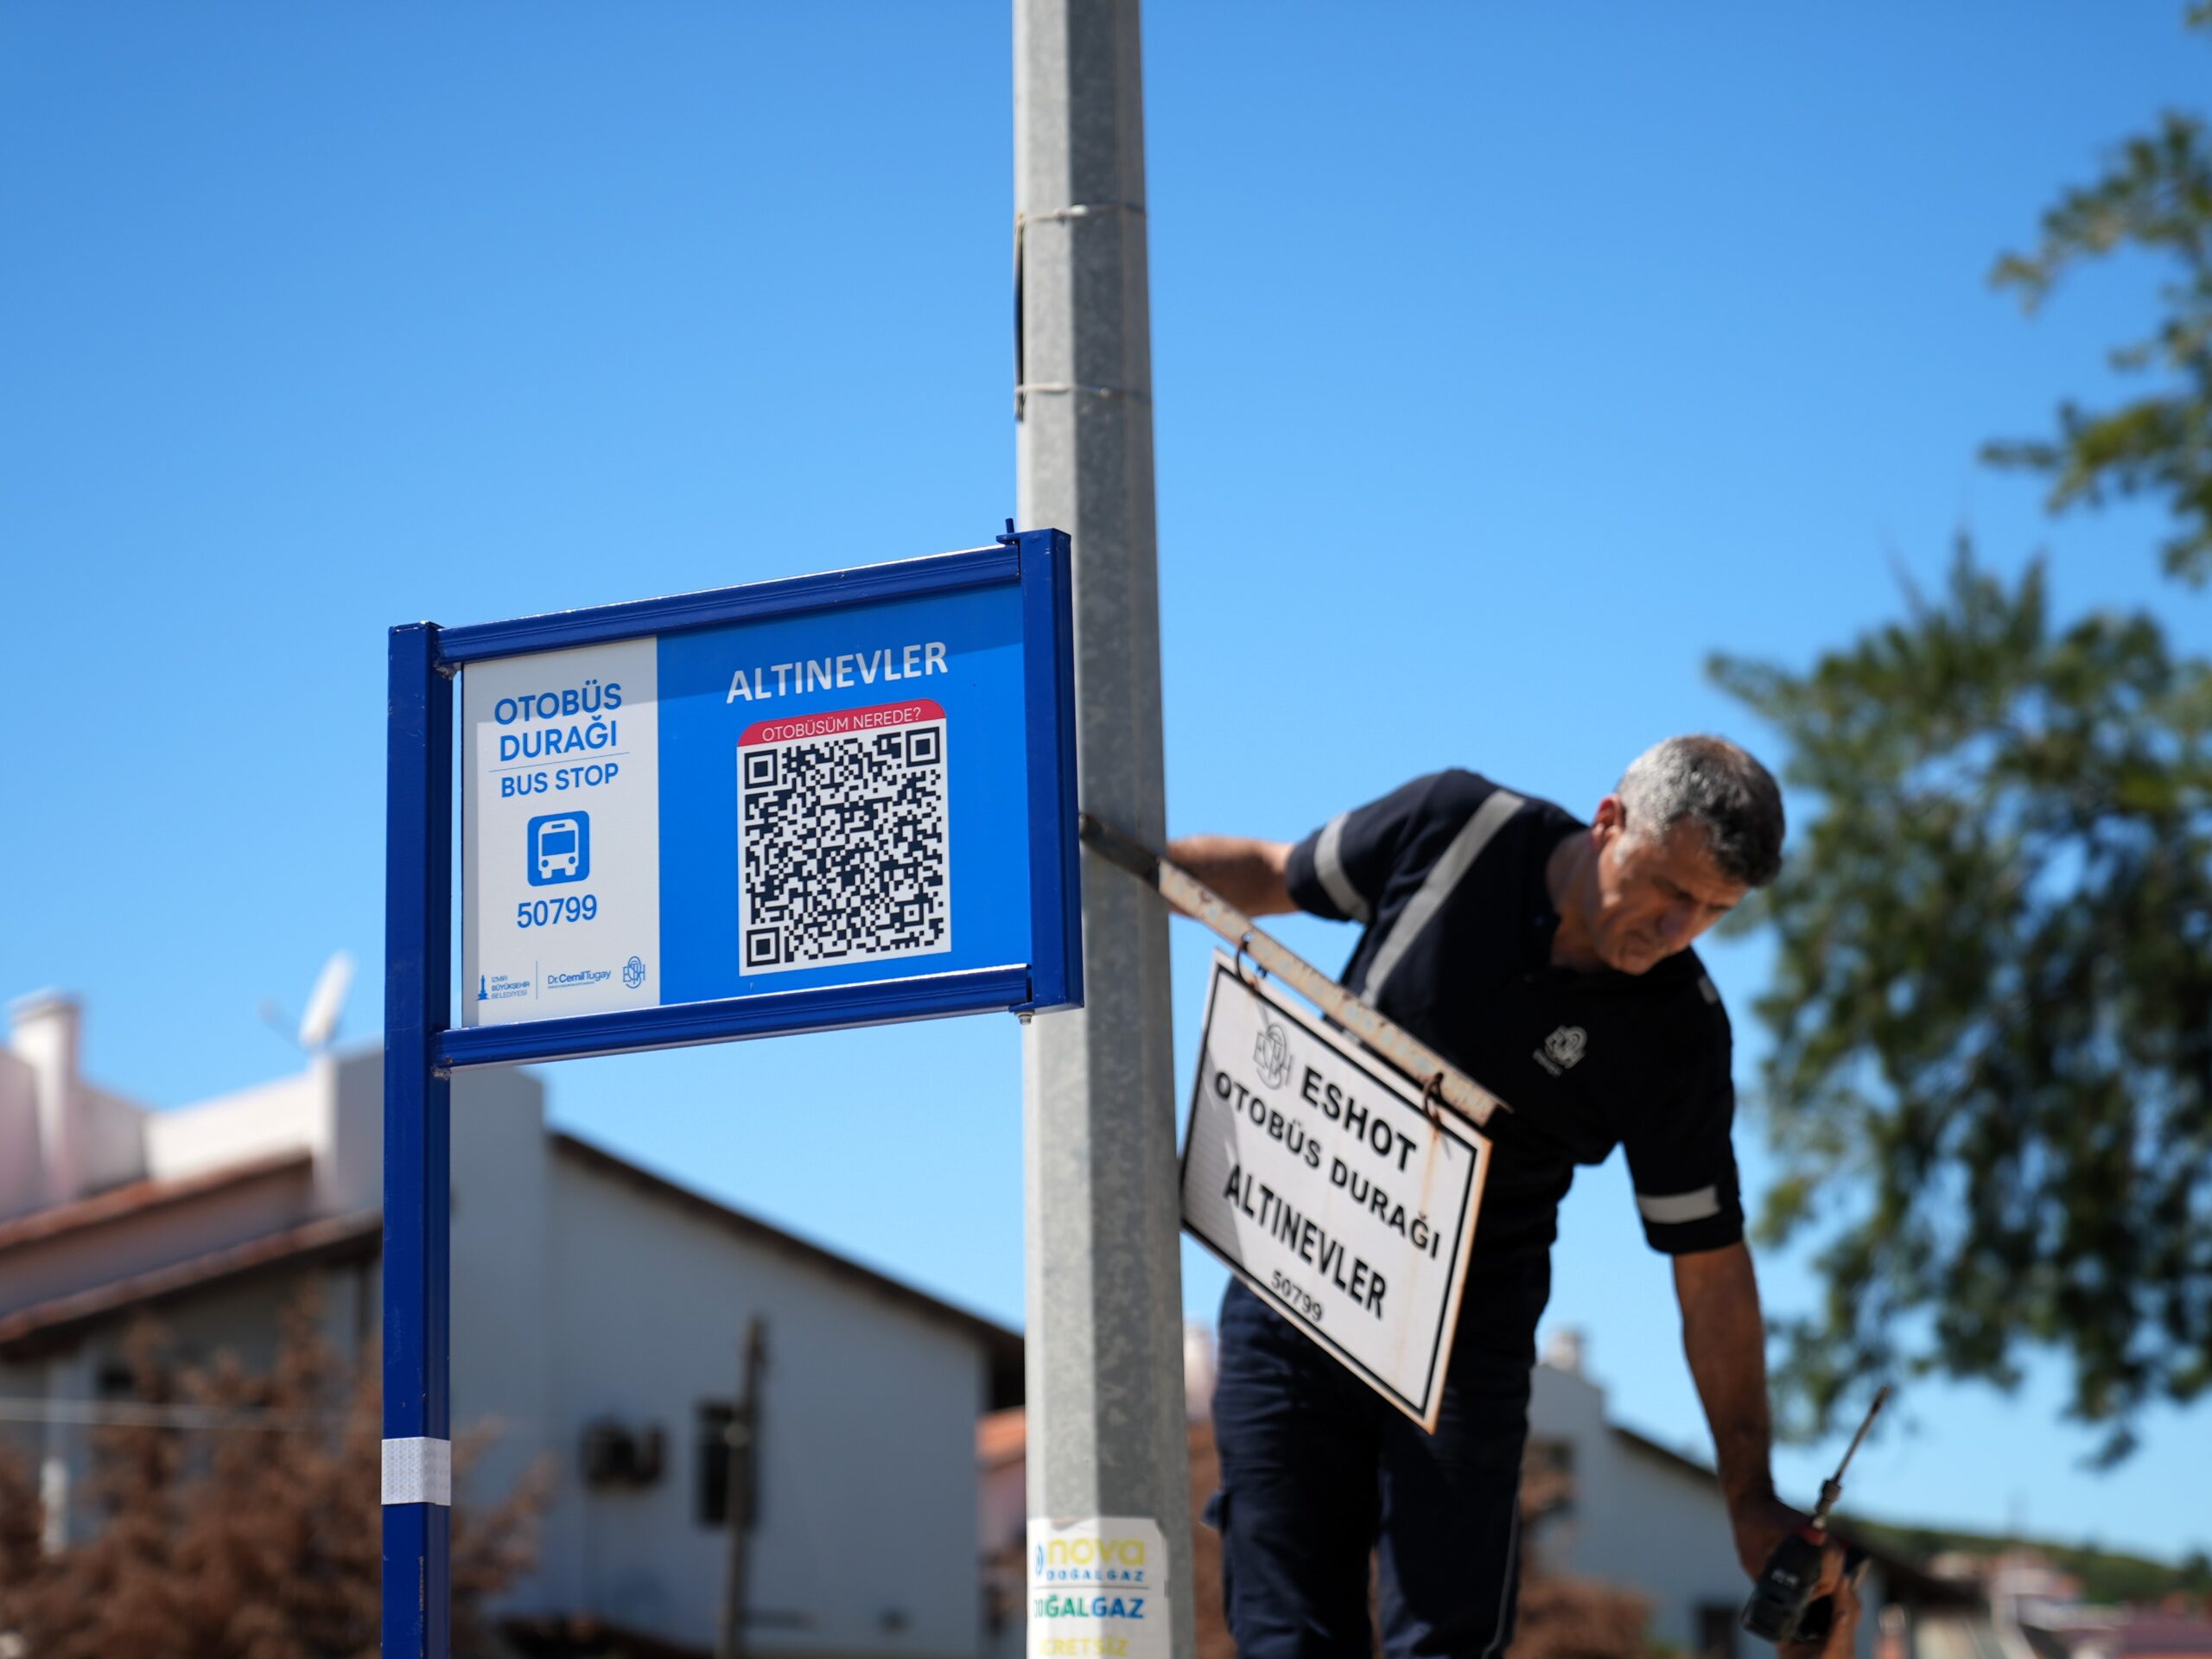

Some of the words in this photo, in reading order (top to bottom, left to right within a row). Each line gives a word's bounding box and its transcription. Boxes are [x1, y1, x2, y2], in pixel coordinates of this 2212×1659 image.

[726, 641, 948, 704] ALTINEVLER
[494, 679, 622, 725] OTOBÜS
[761, 716, 849, 741] OTOBÜSÜM
[853, 707, 921, 730] NEREDE?
[499, 715, 617, 762] DURAĞI
[501, 772, 548, 798] BUS
[555, 763, 619, 791] STOP
[517, 893, 597, 929] 50799
[1300, 1065, 1418, 1173] ESHOT
[1214, 1071, 1322, 1169] OTOBÜS
[1330, 1156, 1440, 1261] DURAĞI
[1223, 1163, 1387, 1320] ALTINEVLER
[1270, 1269, 1324, 1323] 50799
[1046, 1537, 1147, 1567] nova
[1046, 1569, 1145, 1581] DOĞALGAZ
